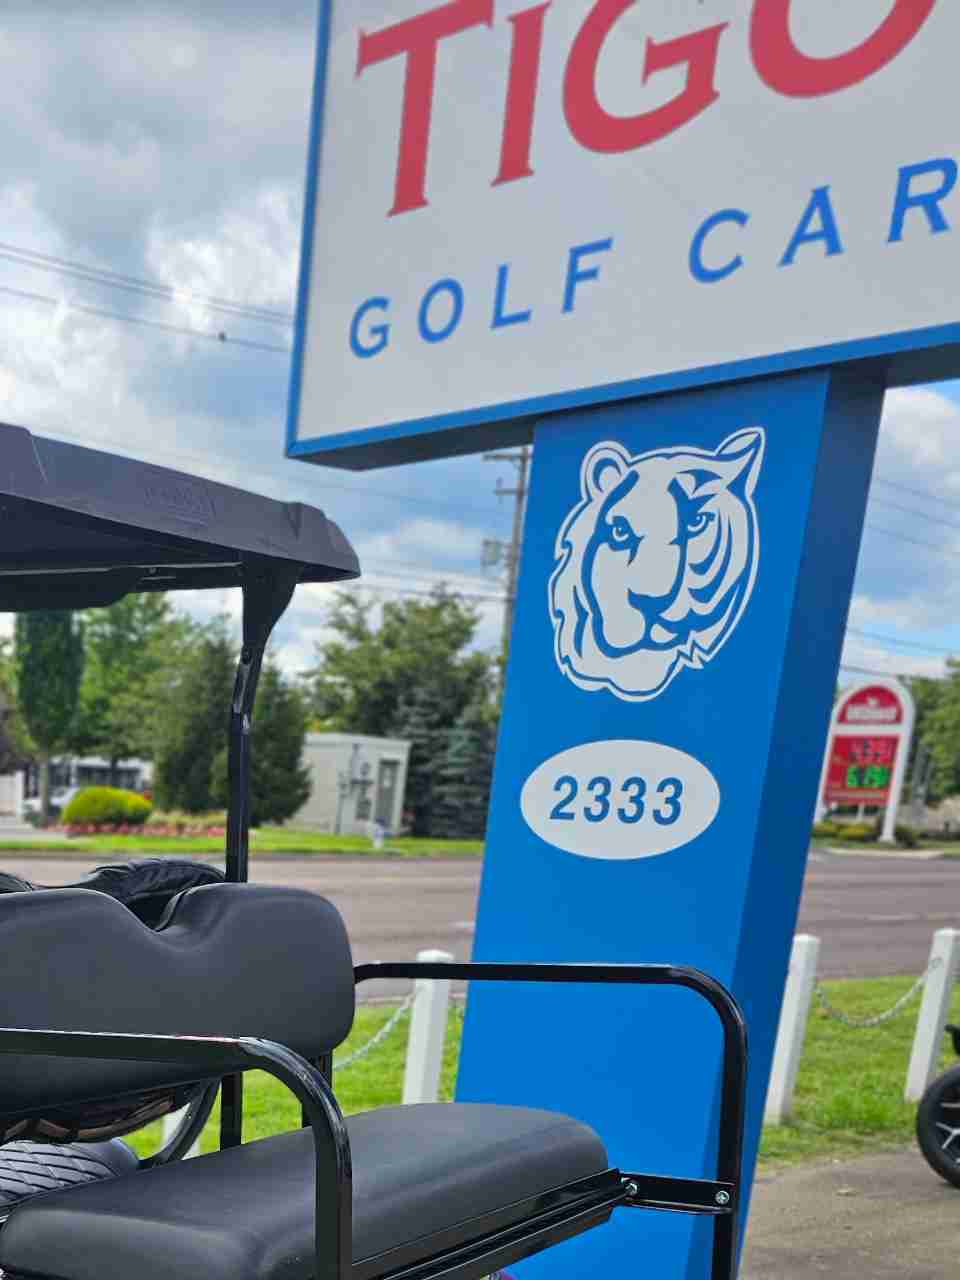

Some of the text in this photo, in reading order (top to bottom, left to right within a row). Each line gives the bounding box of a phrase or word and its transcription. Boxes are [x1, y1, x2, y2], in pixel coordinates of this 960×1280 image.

[349, 156, 959, 359] GOLF CAR
[549, 774, 684, 826] 2333
